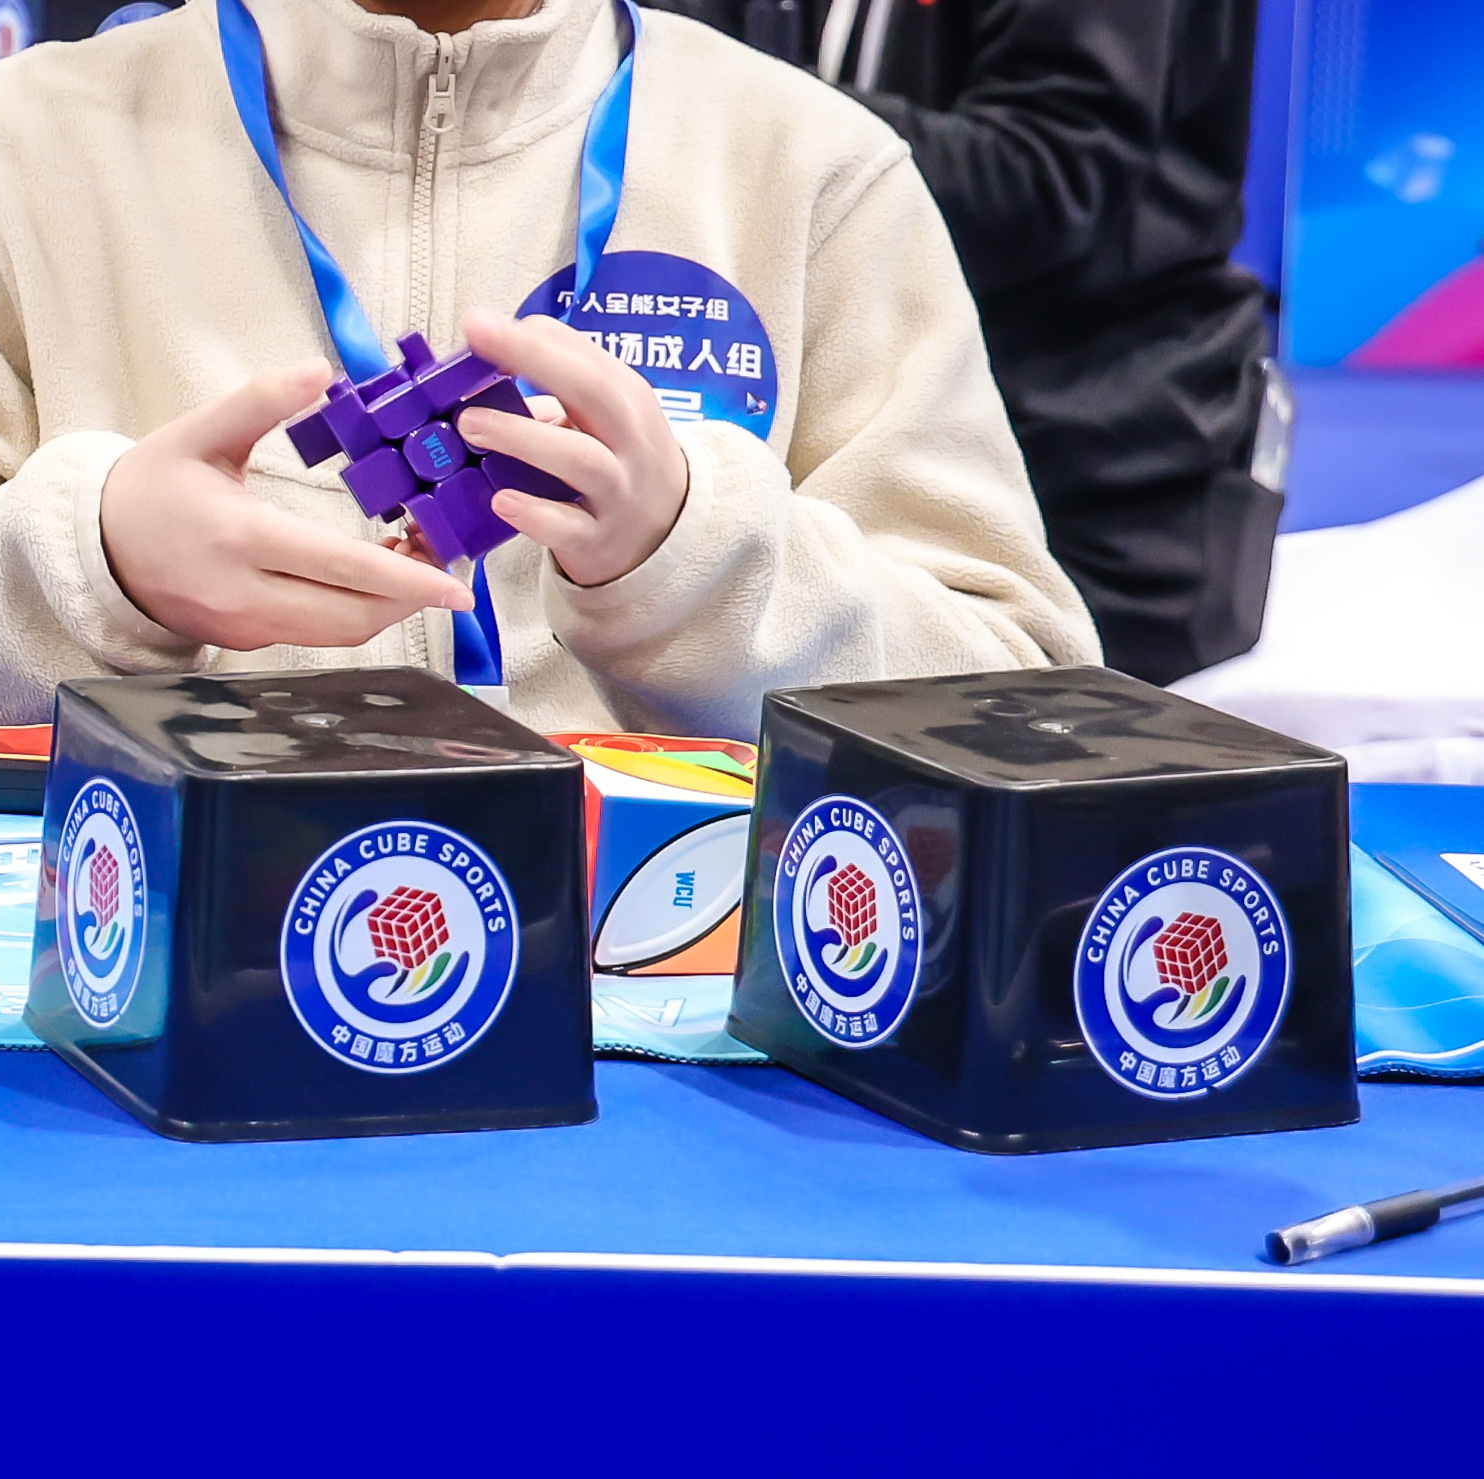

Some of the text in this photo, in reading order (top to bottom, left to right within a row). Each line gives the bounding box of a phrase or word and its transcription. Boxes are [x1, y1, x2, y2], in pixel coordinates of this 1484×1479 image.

[557, 291, 730, 321] 个人全能女子组
[420, 432, 452, 469] WCU
[63, 790, 143, 918] CHINA CUBE SPORTS
[783, 807, 914, 941] CHINA CUBE SPORTS
[295, 832, 506, 935] CHINA CUBE SPORTS
[672, 870, 696, 909] WCU
[1087, 858, 1278, 963] CHINA CUBE SPORTS
[796, 972, 879, 1037] 中国魔方运动
[331, 1021, 465, 1064] 中国魔方运动
[1118, 1045, 1241, 1088] 中国魔方运动
